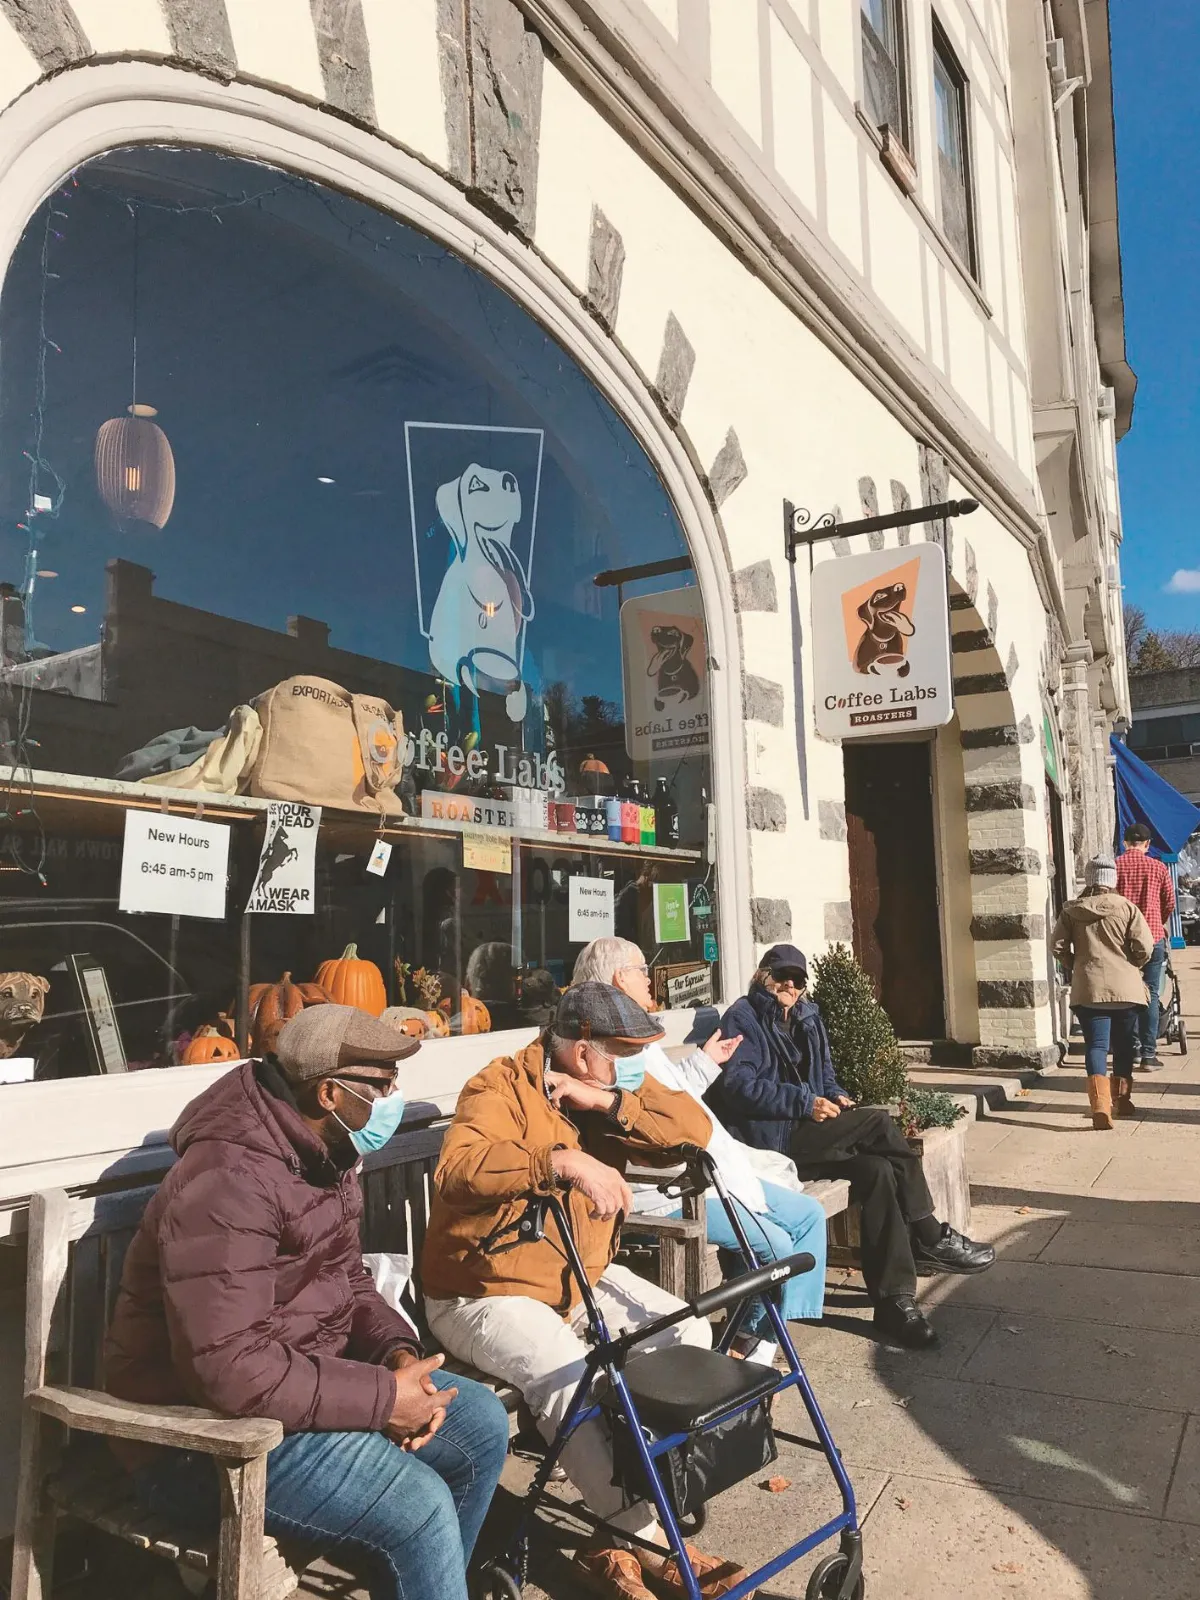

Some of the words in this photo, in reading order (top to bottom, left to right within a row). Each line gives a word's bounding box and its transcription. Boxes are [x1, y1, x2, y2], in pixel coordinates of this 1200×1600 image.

[824, 692, 883, 710] Coffee
[889, 685, 937, 703] Labs
[854, 710, 913, 723] ROASTERS
[494, 743, 566, 794] Labs
[277, 803, 312, 817] YOUR
[278, 815, 315, 829] HEAD
[148, 828, 175, 843] New
[179, 833, 210, 849] Hours
[141, 861, 166, 875] 6:45
[169, 866, 196, 879] am-5
[197, 871, 214, 882] pm
[269, 887, 310, 900] WEAR
[579, 886, 592, 896] New
[592, 887, 607, 897] Hours
[248, 899, 255, 911] A
[256, 899, 296, 912] MASK
[577, 908, 590, 917] 6:45
